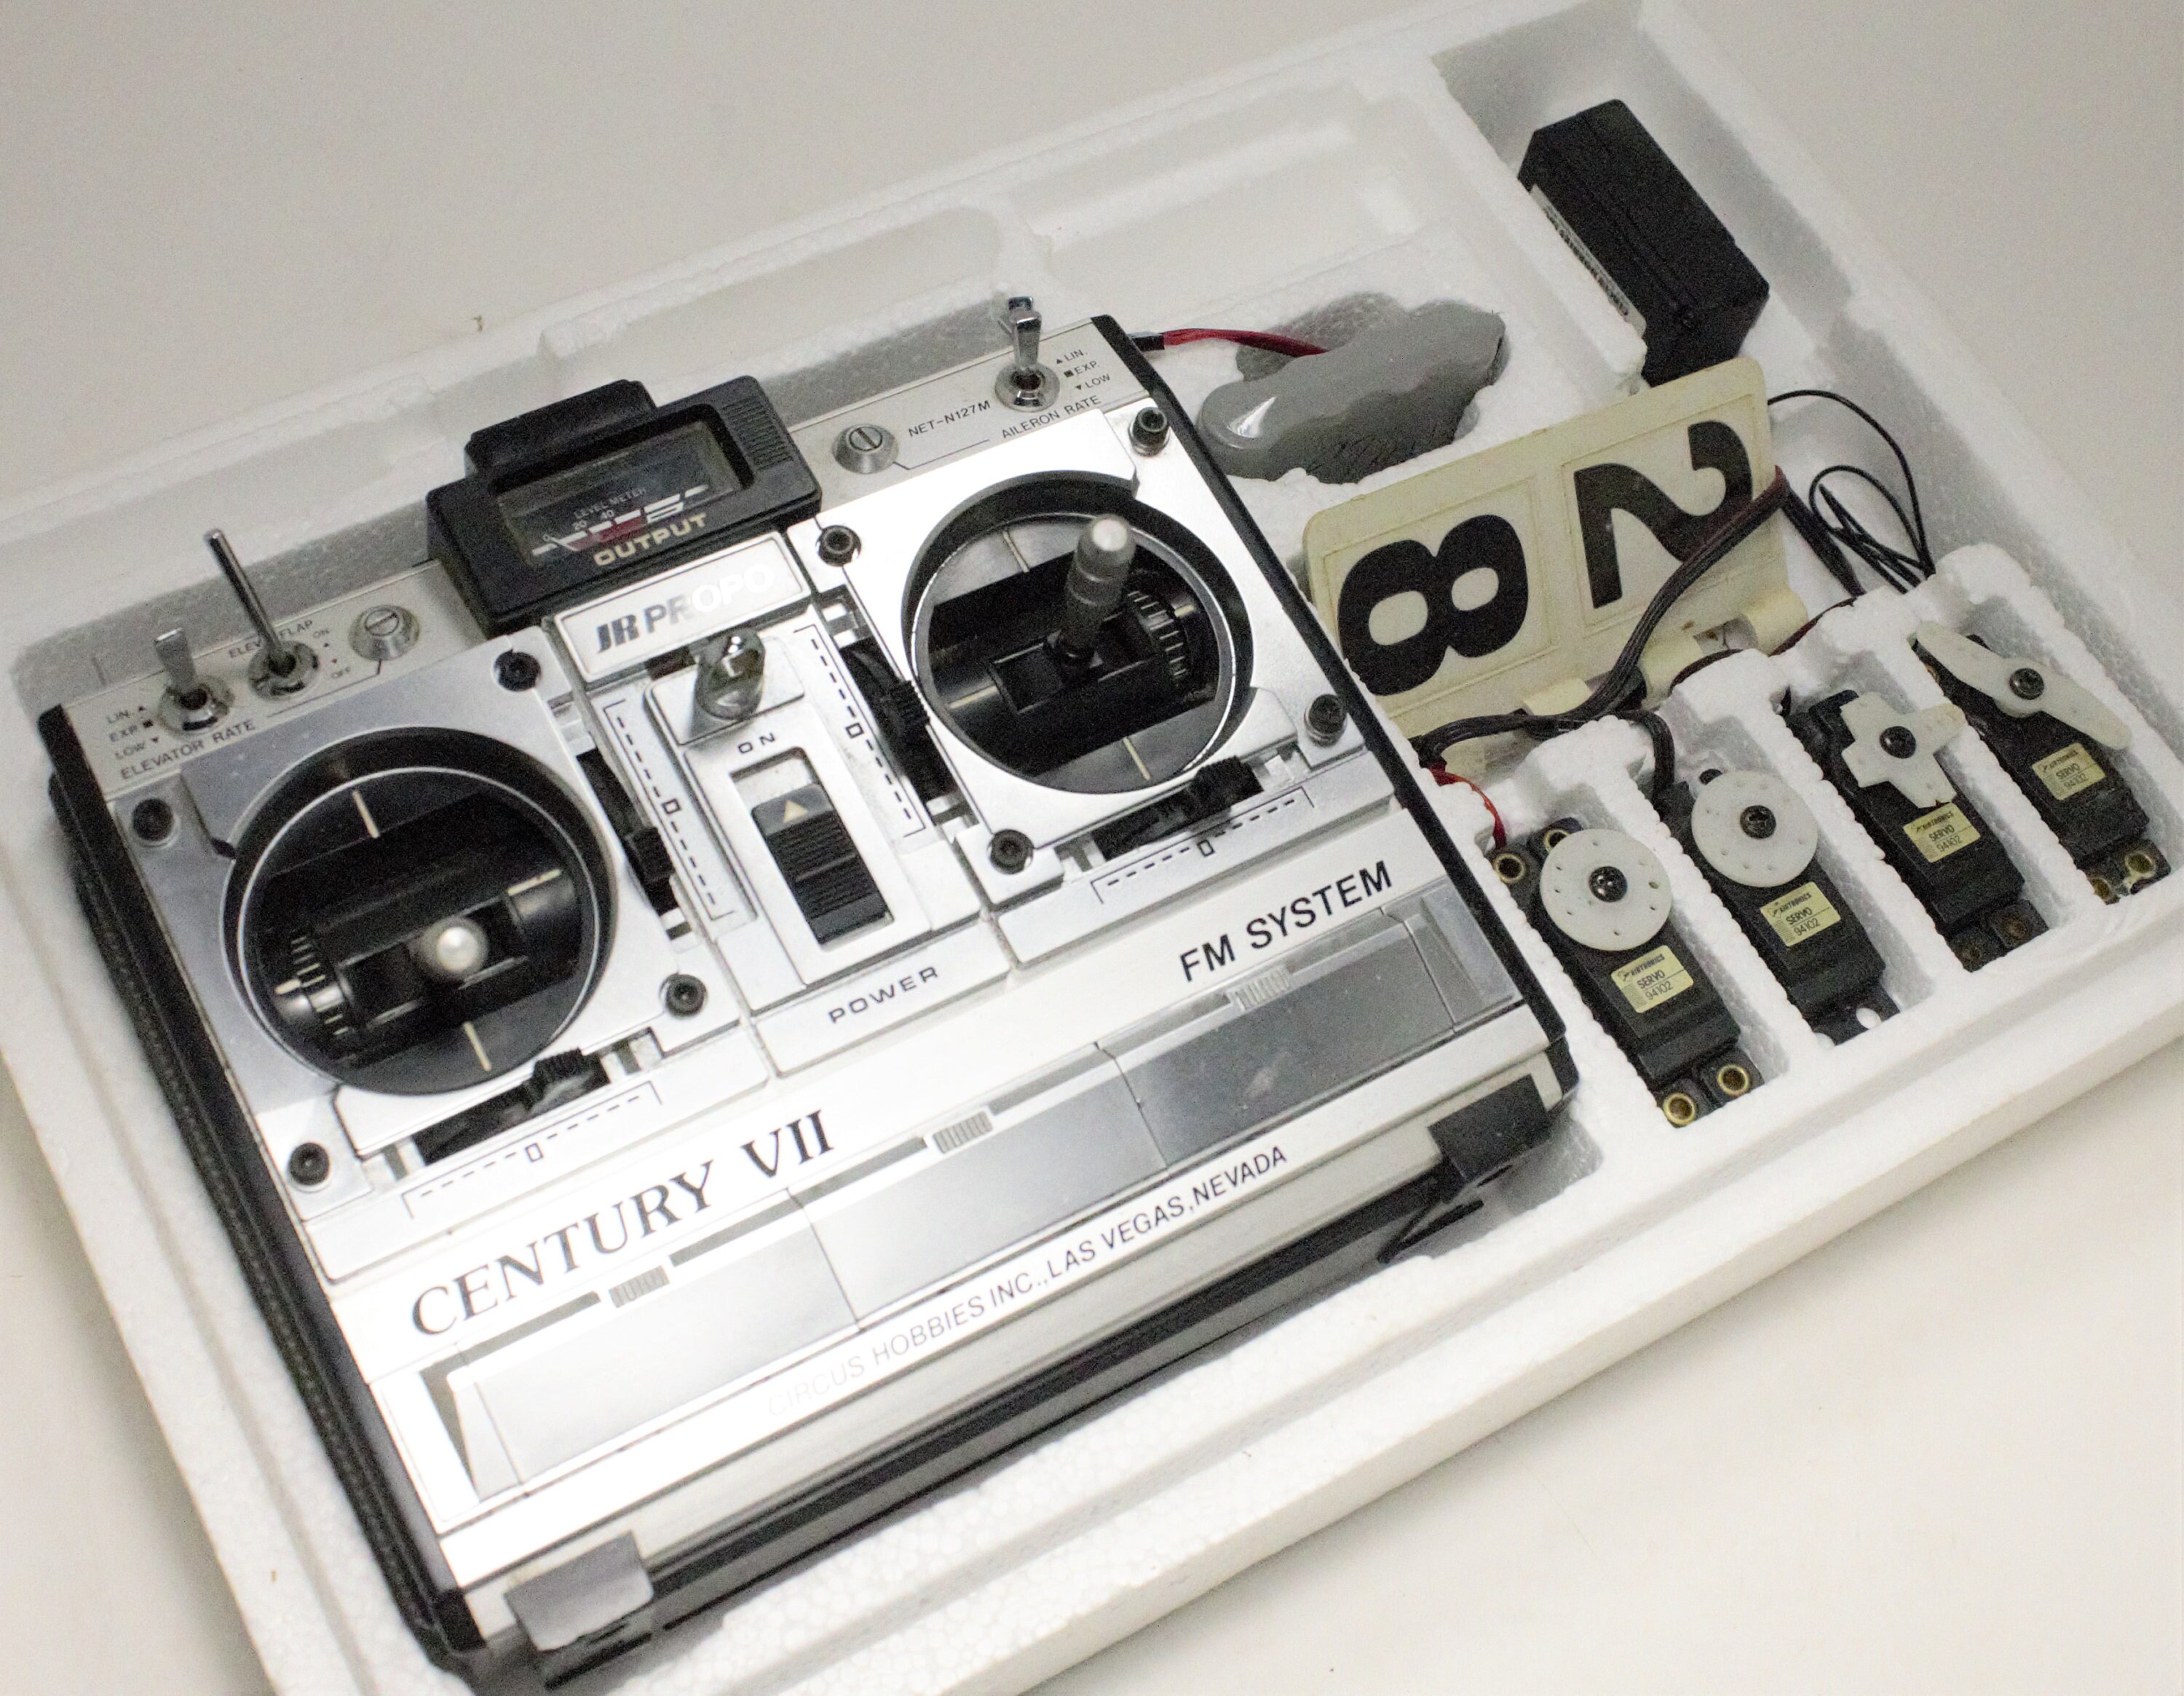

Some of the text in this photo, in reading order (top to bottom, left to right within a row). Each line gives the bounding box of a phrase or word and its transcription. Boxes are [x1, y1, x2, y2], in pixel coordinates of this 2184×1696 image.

[1064, 349, 1088, 362] LIN.
[1074, 360, 1100, 375] EXP.
[1085, 373, 1110, 389] LOW
[909, 400, 991, 437] NET-N127M
[1001, 395, 1101, 439] AILERON RATE
[601, 510, 614, 520] 40
[593, 512, 708, 567] OUTPUT
[644, 563, 777, 634] PROPO
[330, 665, 352, 681] OFF
[114, 741, 146, 760] LOW
[119, 718, 256, 780] ELEVATOR RATE
[737, 732, 777, 754] ON
[2055, 762, 2081, 780] SERVO
[1928, 824, 1955, 843] SERVO
[1179, 860, 1393, 982] FM SYSTEM
[1786, 906, 1813, 925] SERVO
[1794, 917, 1821, 936] 94102
[1637, 969, 1666, 990] SERVO
[828, 966, 938, 1023] POWER
[1645, 980, 1674, 1001] 94102
[411, 1108, 835, 1336] CENTURY VII
[768, 1355, 866, 1416] CIRCUS
[871, 1295, 985, 1366] HOBBIES
